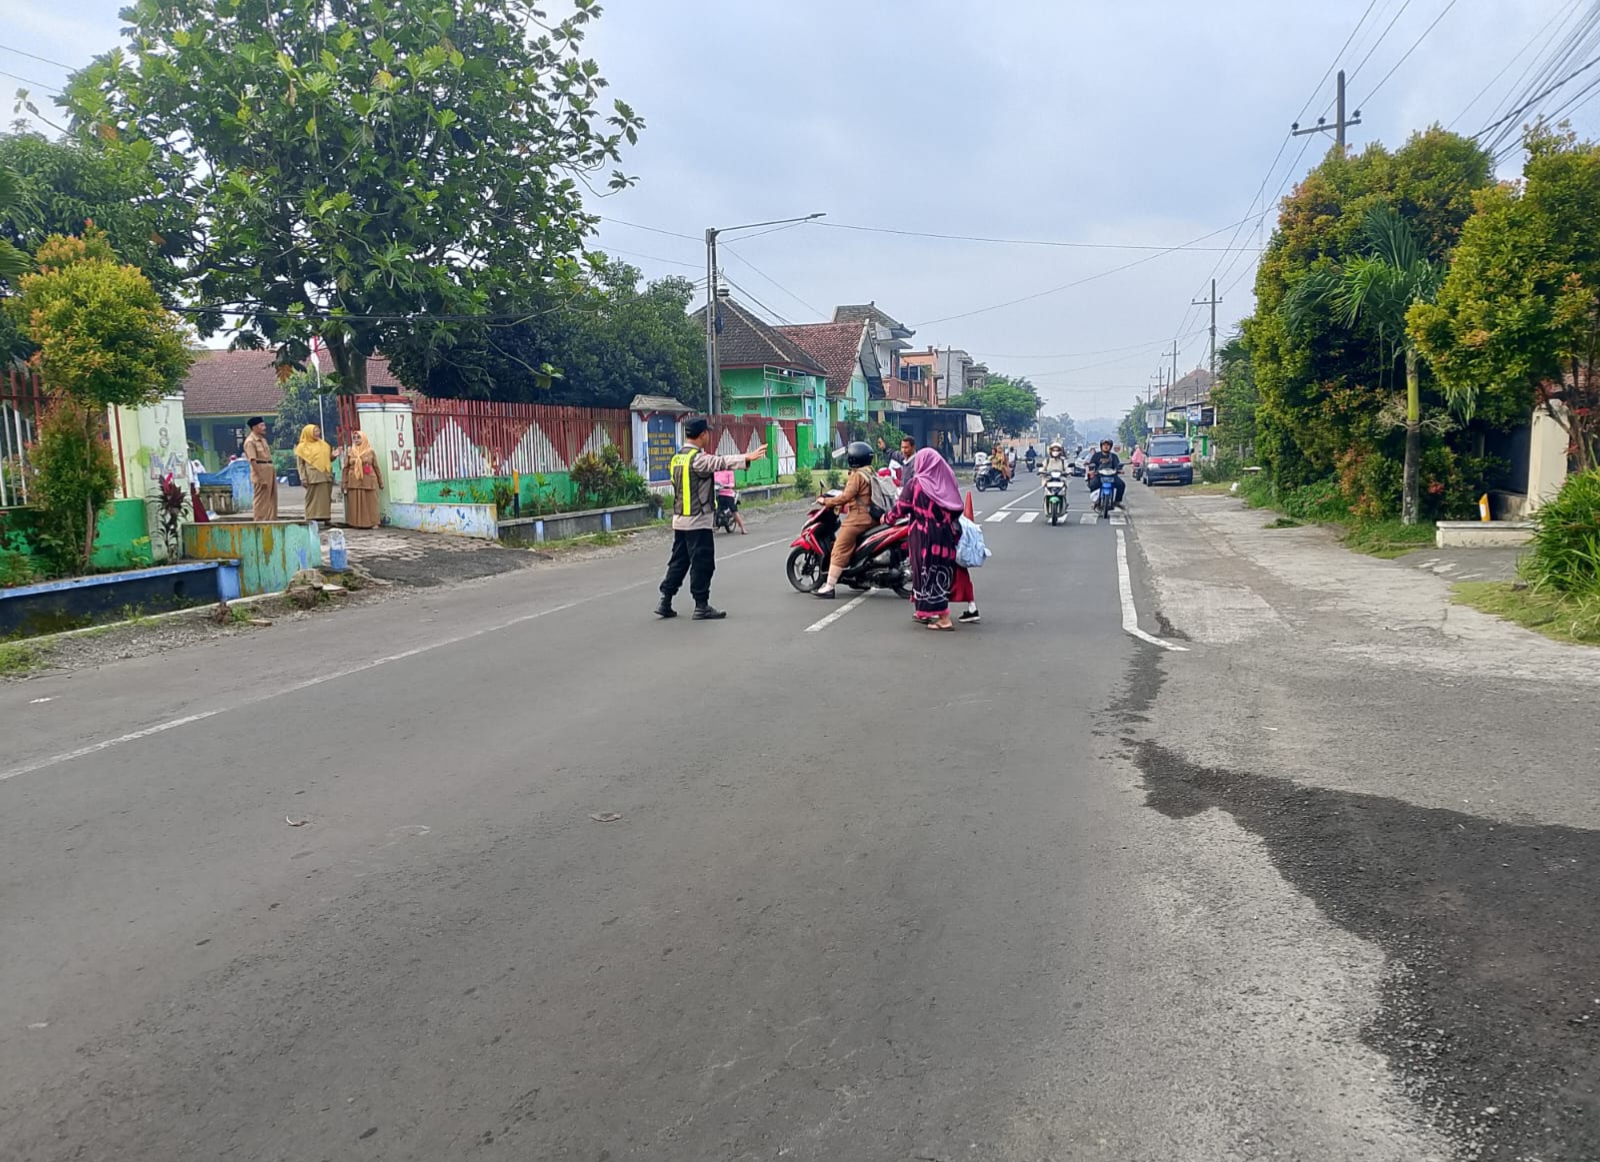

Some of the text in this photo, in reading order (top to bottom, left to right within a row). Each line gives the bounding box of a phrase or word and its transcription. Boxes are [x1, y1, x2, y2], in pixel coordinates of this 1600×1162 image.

[395, 414, 405, 431] 17
[159, 427, 169, 449] 8
[398, 432, 405, 448] 8
[390, 449, 413, 471] 1945
